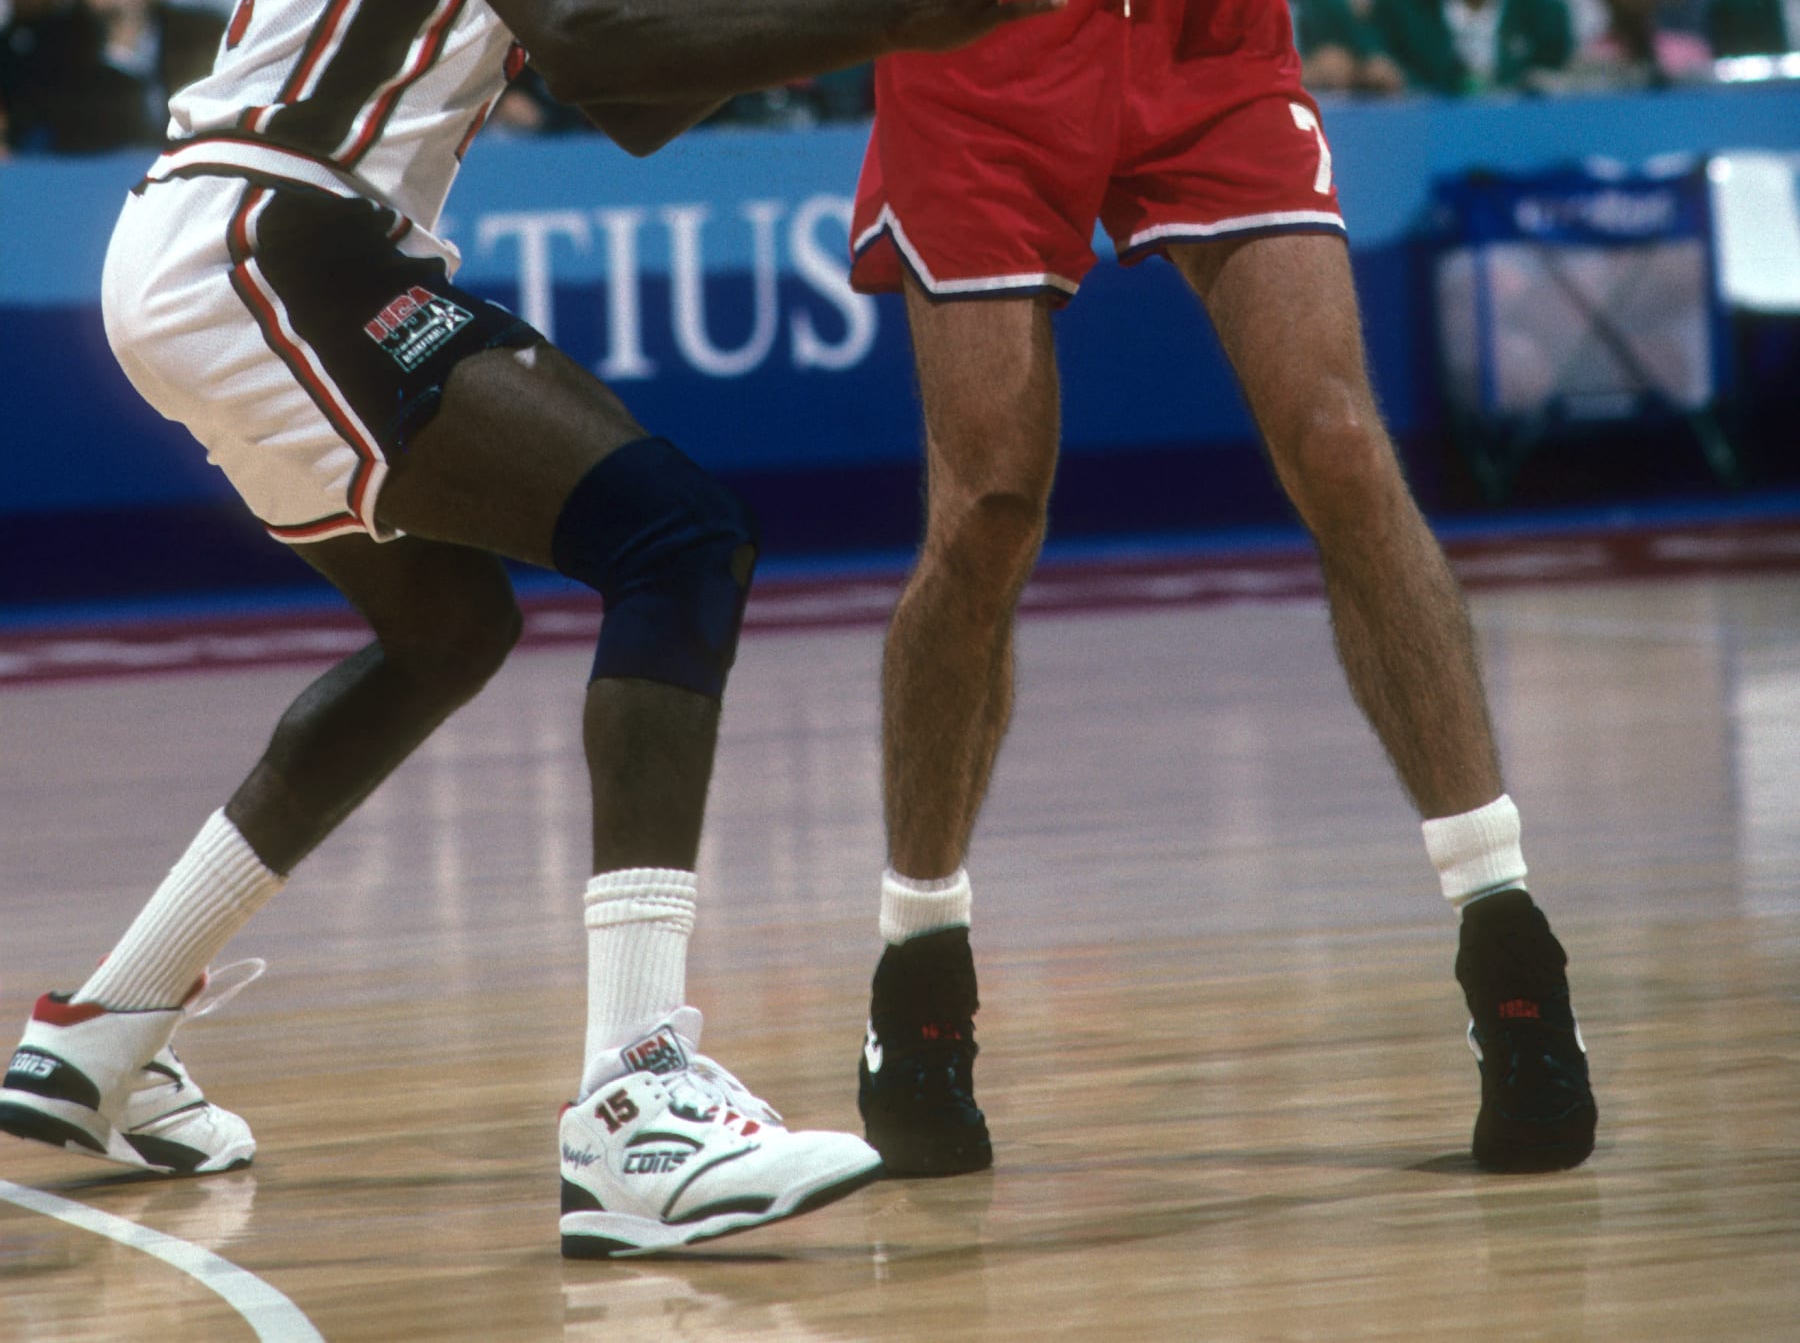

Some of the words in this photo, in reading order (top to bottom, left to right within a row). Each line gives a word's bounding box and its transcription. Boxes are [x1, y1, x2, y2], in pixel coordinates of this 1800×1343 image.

[1288, 101, 1332, 195] 7
[363, 285, 457, 354] USA
[434, 192, 880, 379] TIUS
[594, 1088, 640, 1135] 15
